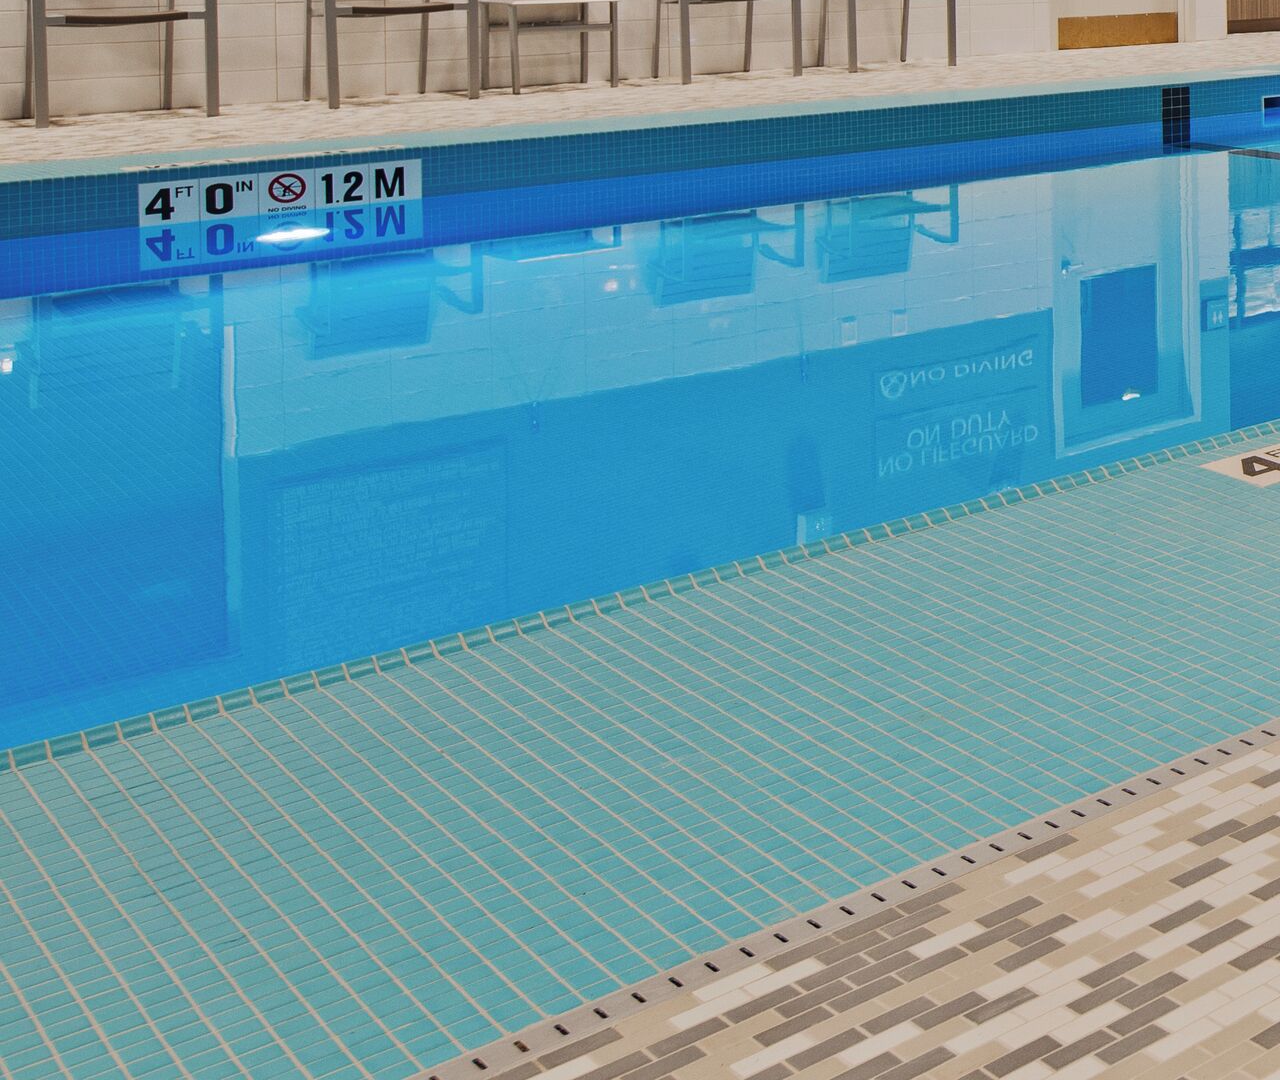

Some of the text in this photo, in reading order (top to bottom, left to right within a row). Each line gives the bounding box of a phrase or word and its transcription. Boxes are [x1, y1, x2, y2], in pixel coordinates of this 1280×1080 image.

[145, 188, 175, 220] 4
[175, 186, 194, 198] FT
[206, 183, 234, 215] 0
[236, 180, 253, 193] IN
[375, 167, 405, 198] M
